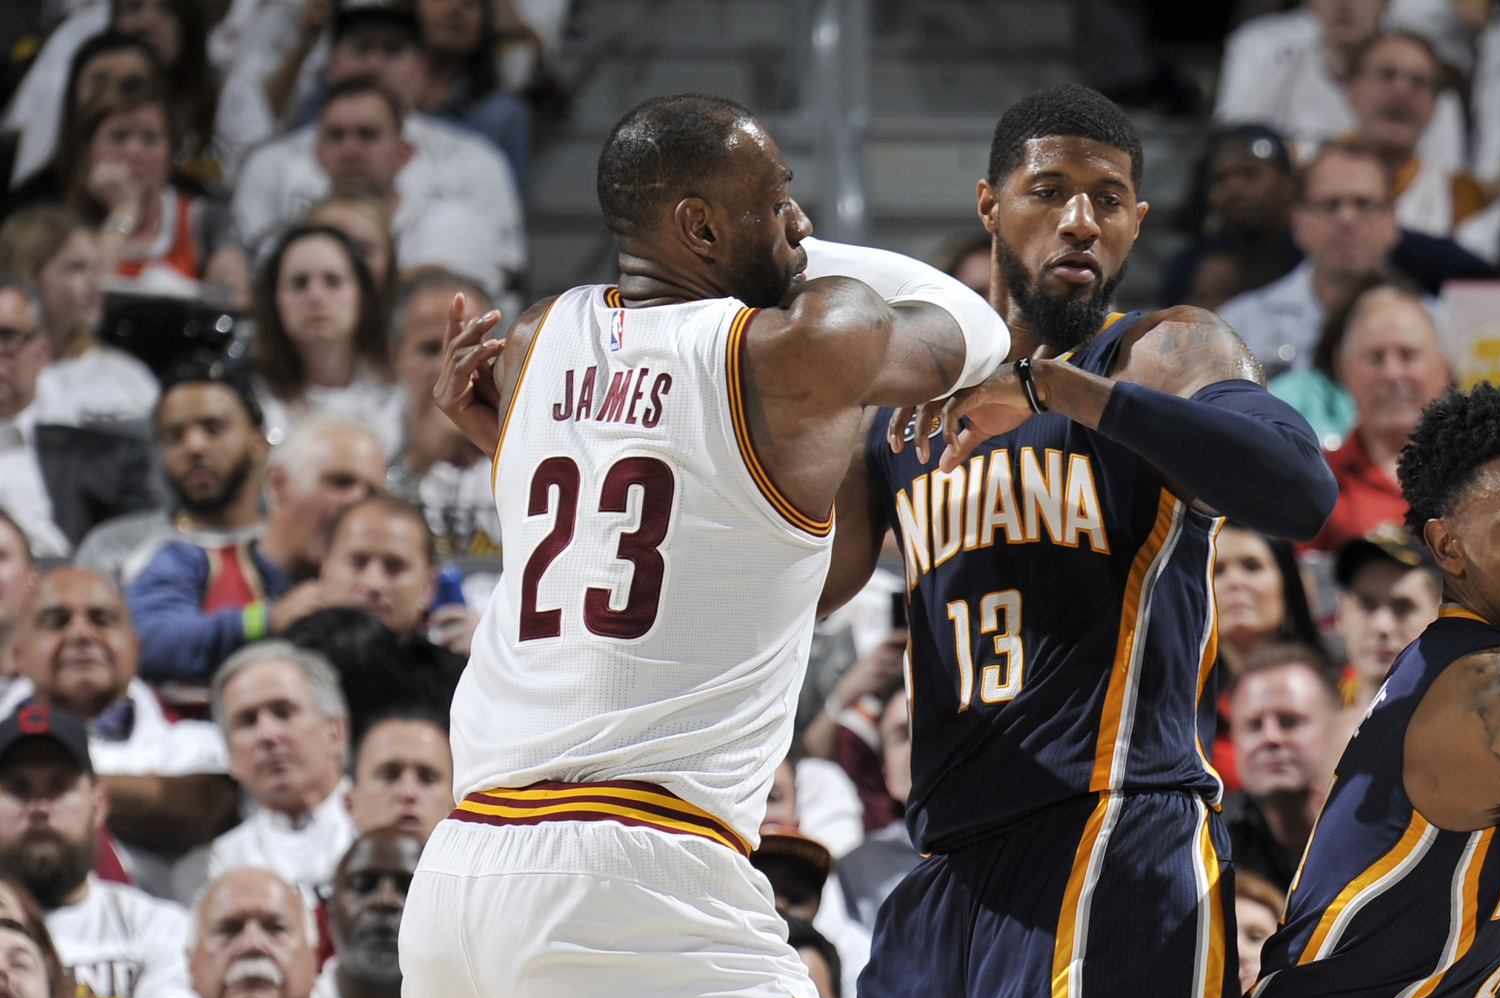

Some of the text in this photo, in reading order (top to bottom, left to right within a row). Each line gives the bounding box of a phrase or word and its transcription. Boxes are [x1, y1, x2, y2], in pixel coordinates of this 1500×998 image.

[552, 365, 673, 429] JAMES
[518, 455, 676, 642] 23
[896, 447, 1111, 596] NDIANA
[947, 588, 1024, 714] 13
